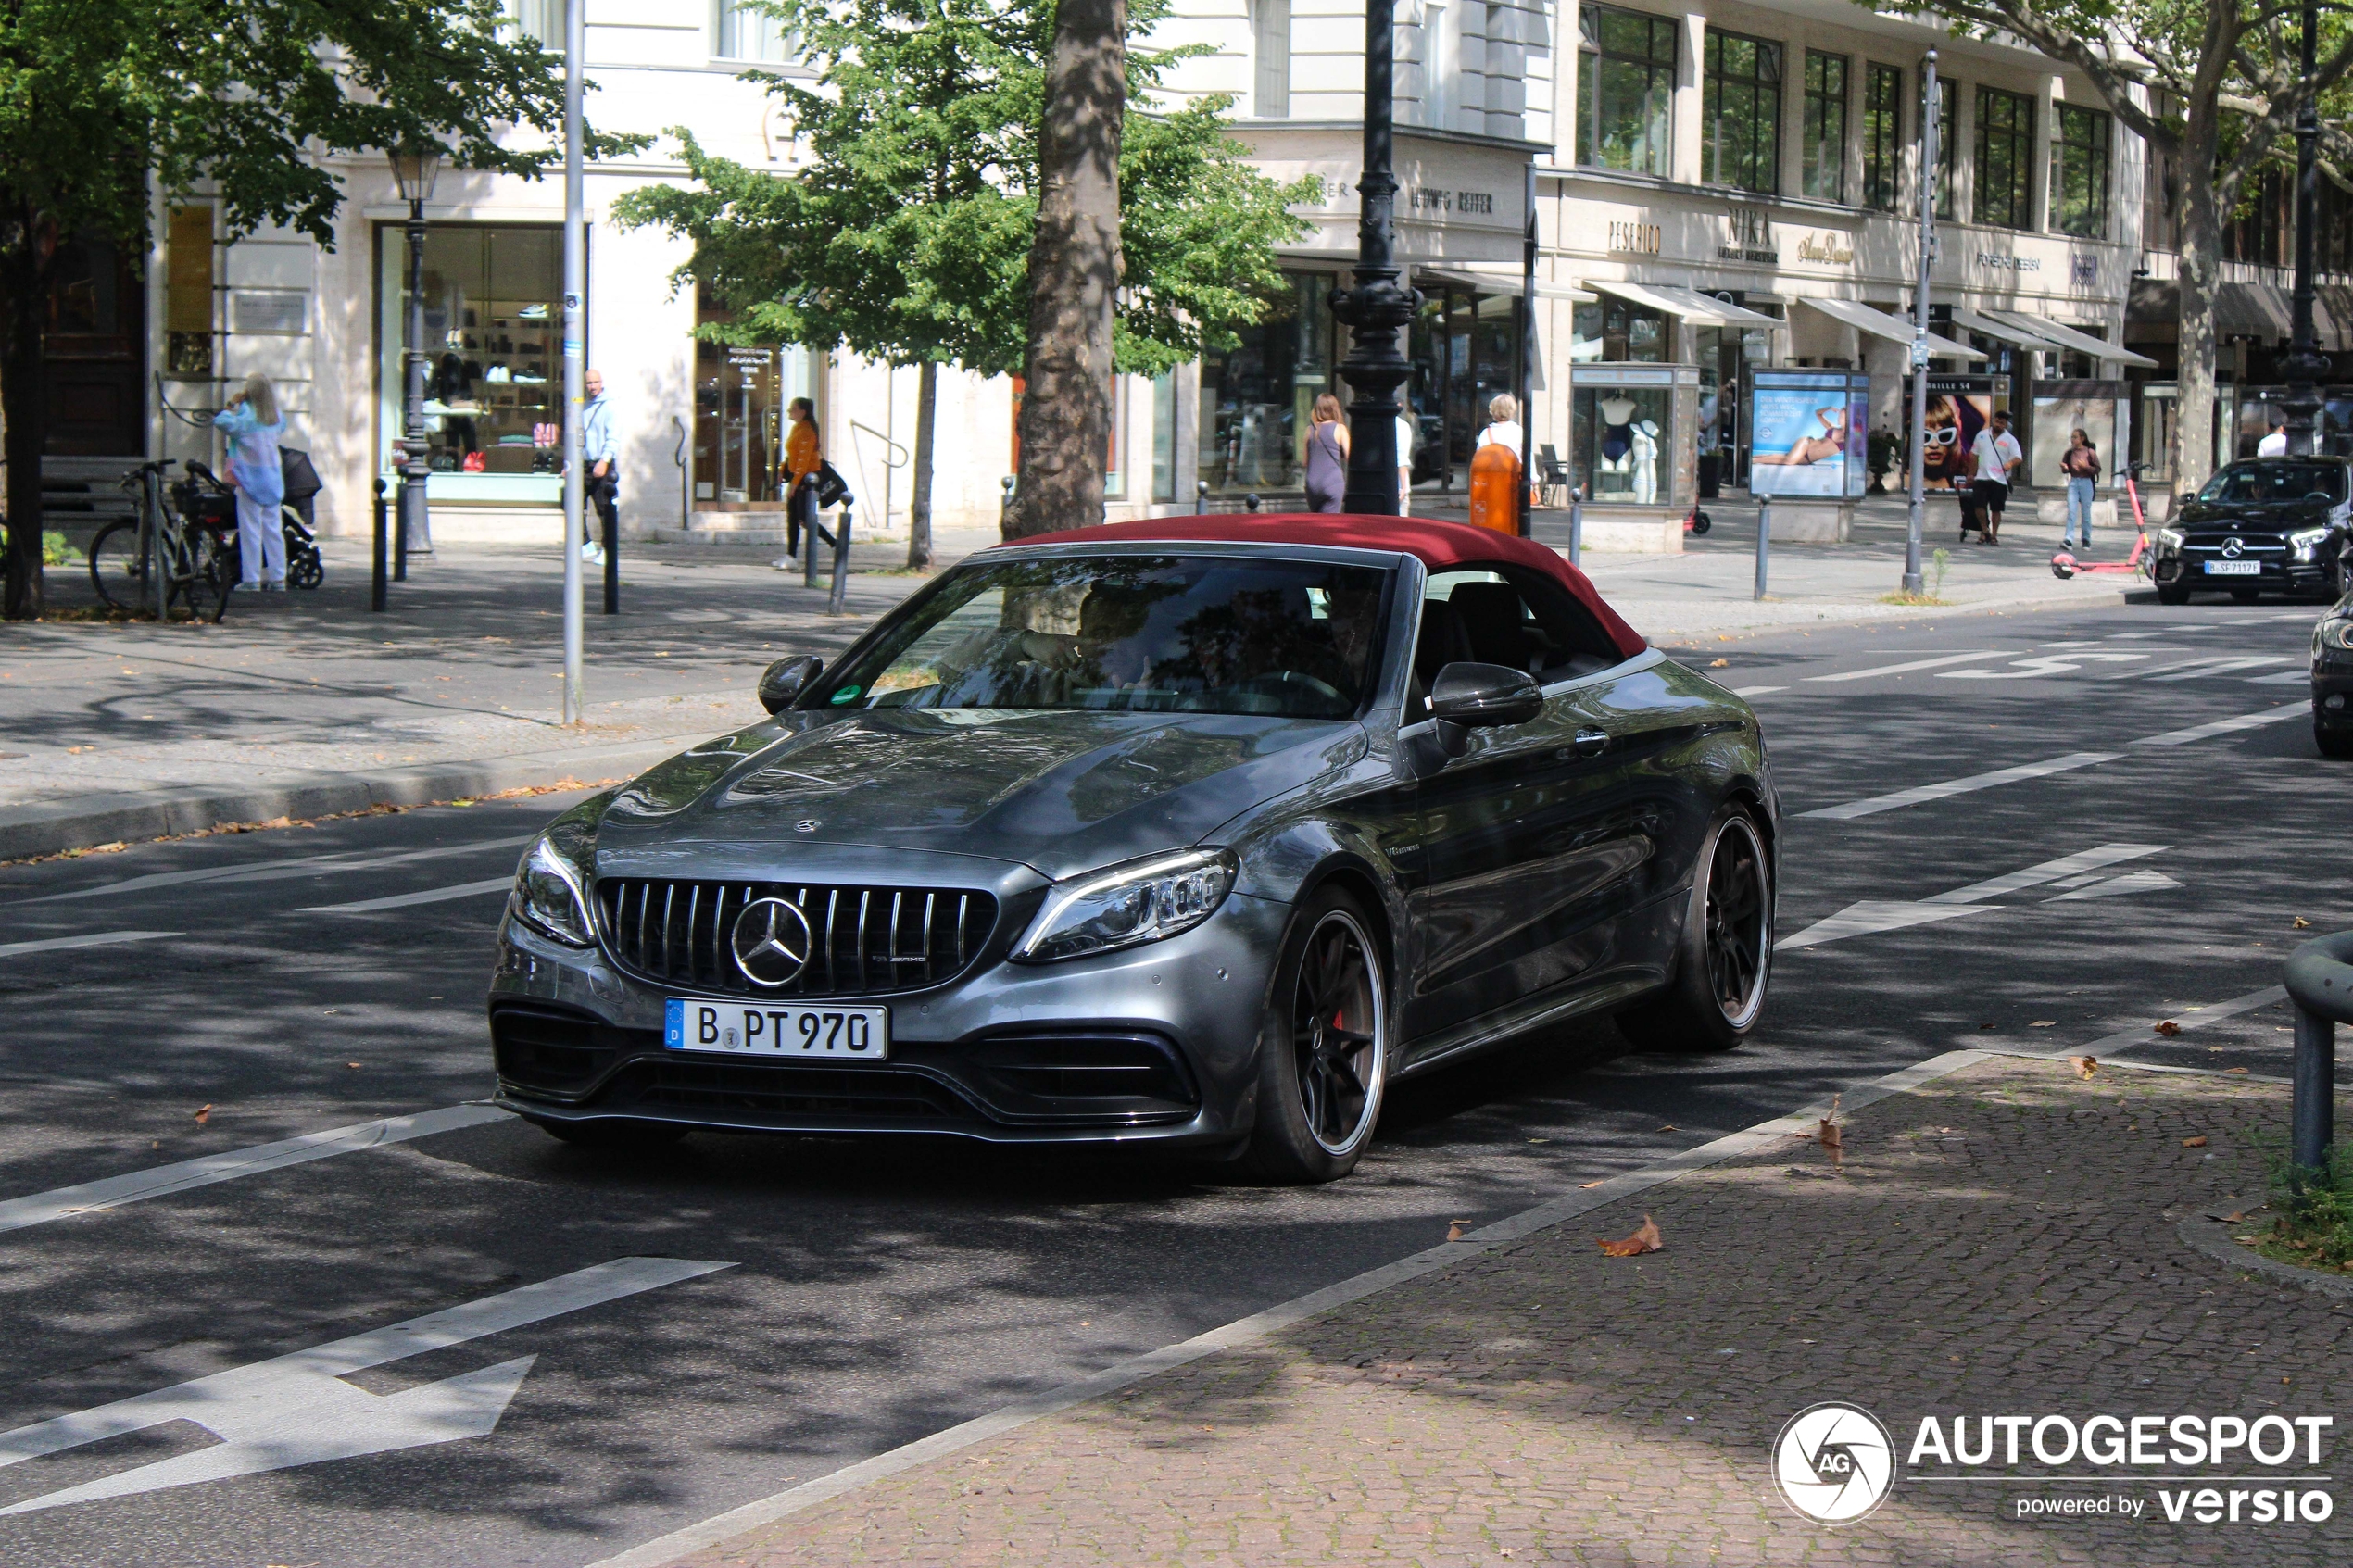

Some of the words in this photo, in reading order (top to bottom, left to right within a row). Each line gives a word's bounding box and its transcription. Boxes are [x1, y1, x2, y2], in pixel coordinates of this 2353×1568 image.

[1411, 187, 1451, 210] LUDWIG
[1458, 191, 1492, 214] REITER
[1609, 220, 1661, 254] PESERICO
[1728, 207, 1770, 245] NIKA
[1976, 251, 2011, 270] PORSCHE
[2013, 256, 2041, 271] DESIGN
[1959, 382, 1970, 390] 54
[2221, 563, 2230, 572] SF
[671, 1030, 679, 1041] D
[698, 1006, 719, 1044] B
[744, 1010, 788, 1048] PT
[799, 1012, 869, 1051] 970
